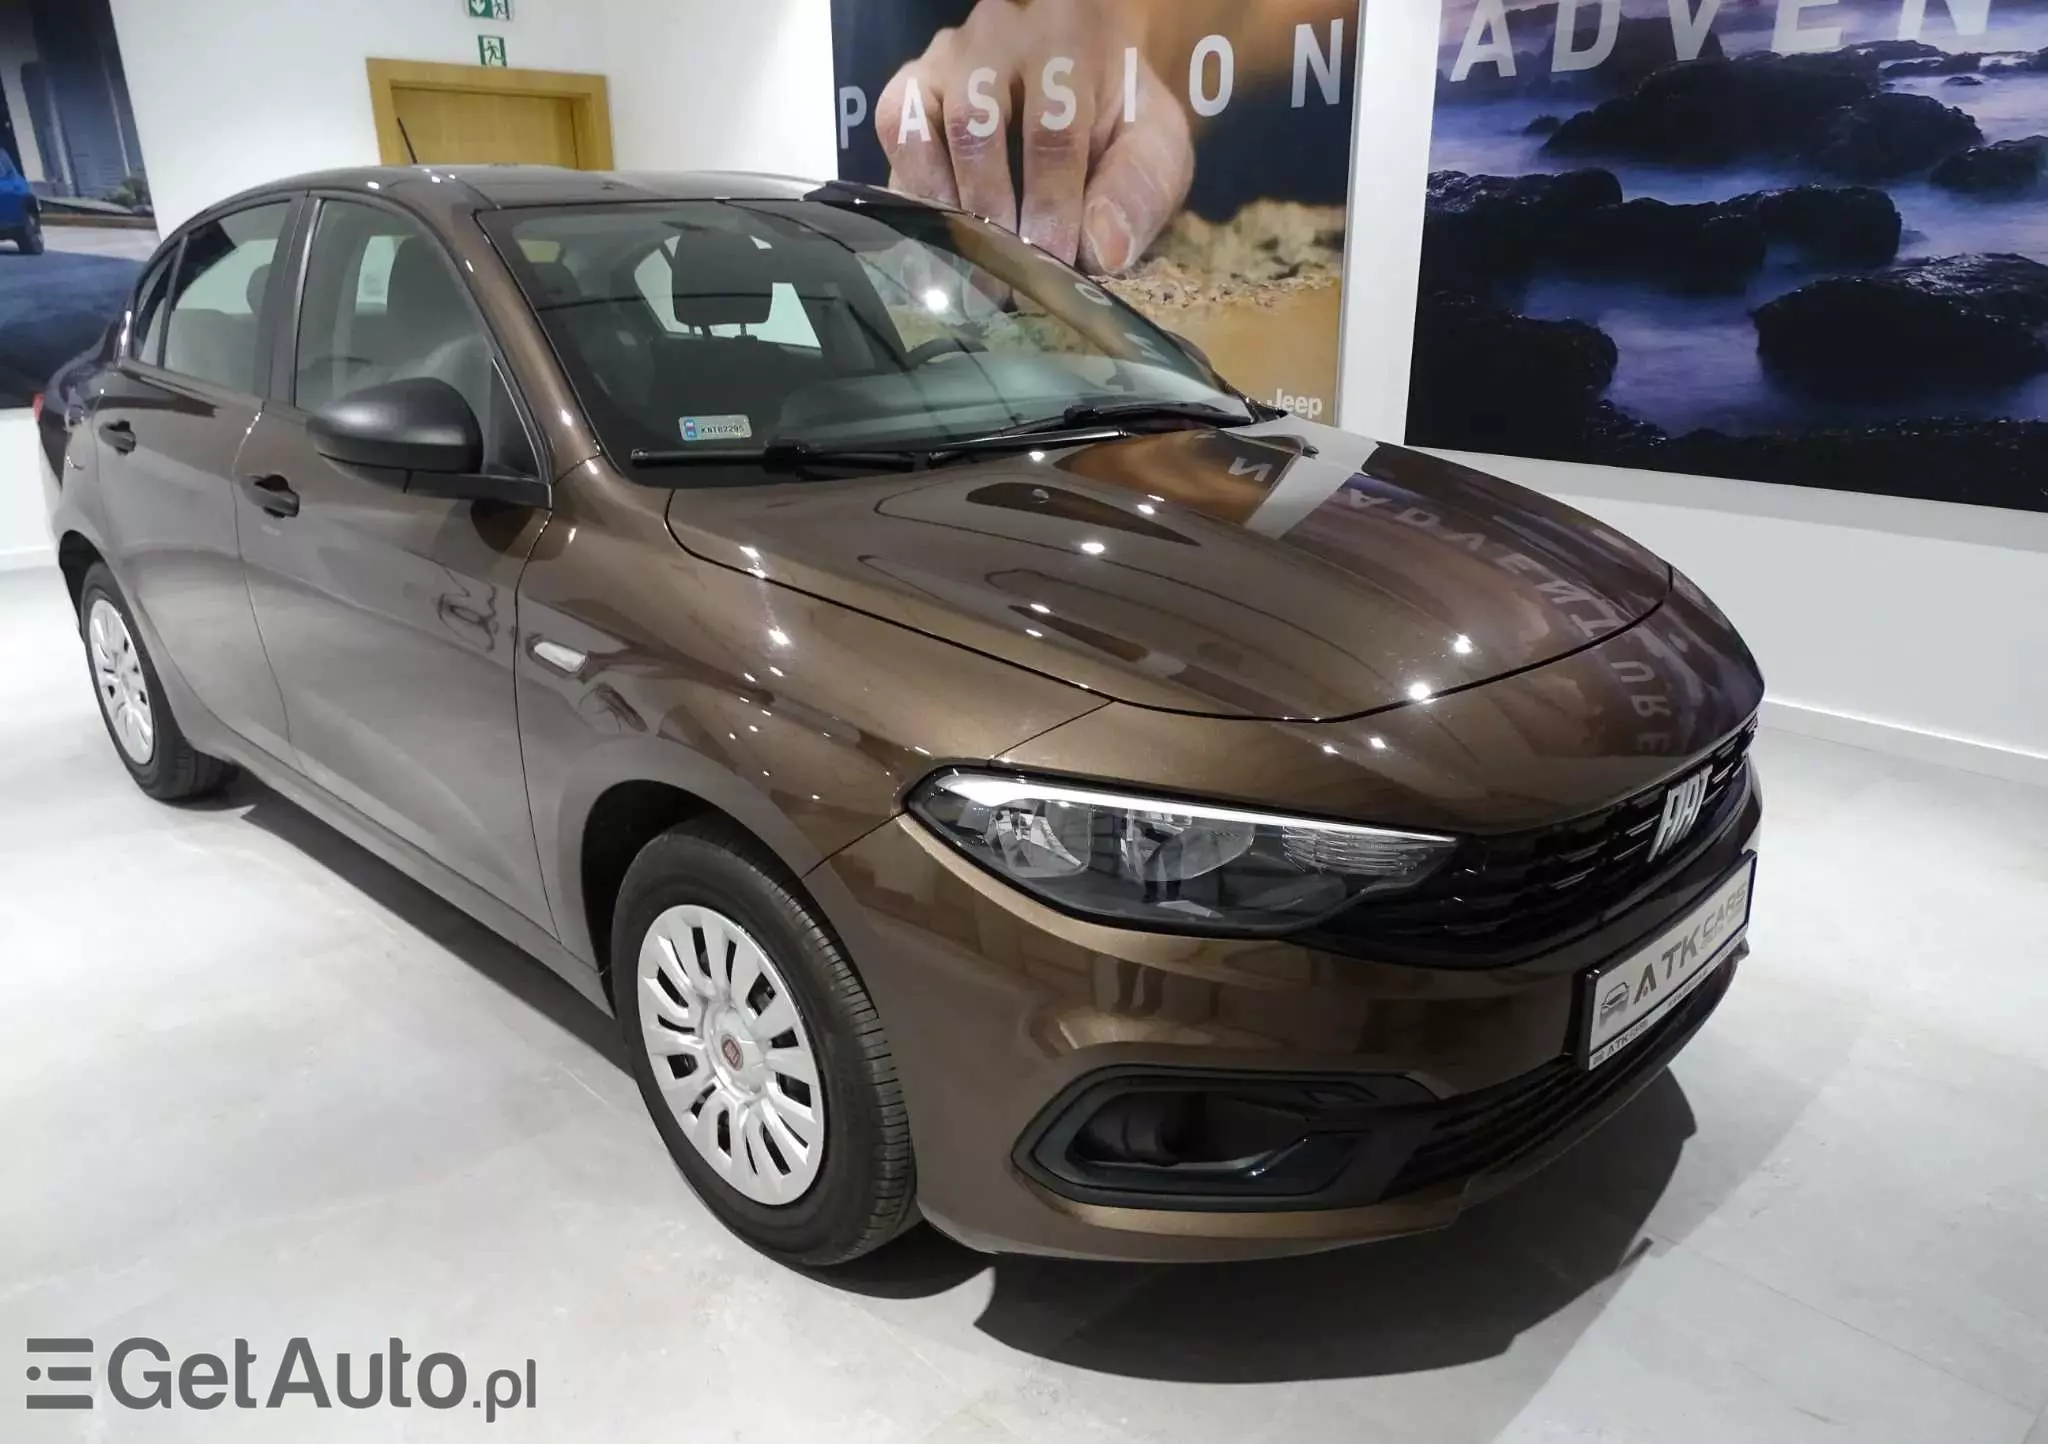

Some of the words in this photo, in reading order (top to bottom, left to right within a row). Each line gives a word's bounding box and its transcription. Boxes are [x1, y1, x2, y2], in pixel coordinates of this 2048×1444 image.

[838, 18, 1344, 150] PASSION
[1267, 388, 1323, 419] Jeep
[1647, 764, 1714, 863] FIAT
[1632, 924, 1701, 1005] ATK
